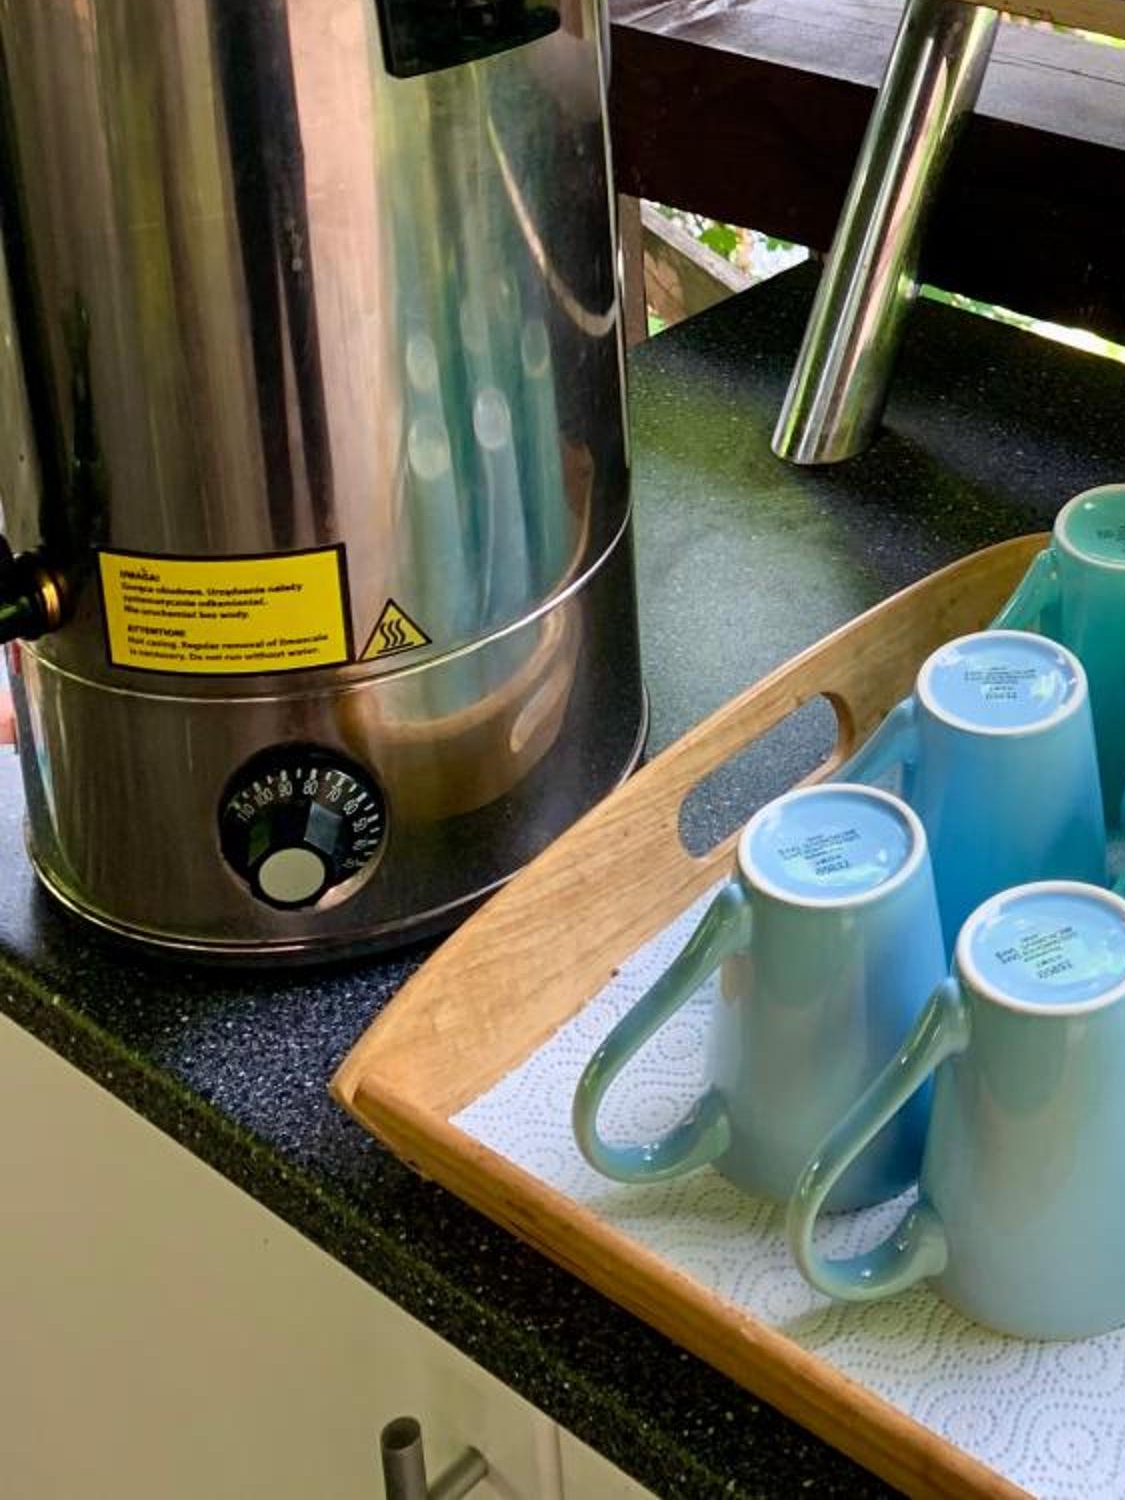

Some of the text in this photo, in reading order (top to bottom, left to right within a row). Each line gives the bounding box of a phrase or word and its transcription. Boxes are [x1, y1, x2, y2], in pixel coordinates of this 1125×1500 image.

[277, 780, 293, 798] 90
[302, 779, 319, 796] 80
[326, 786, 342, 802] 70
